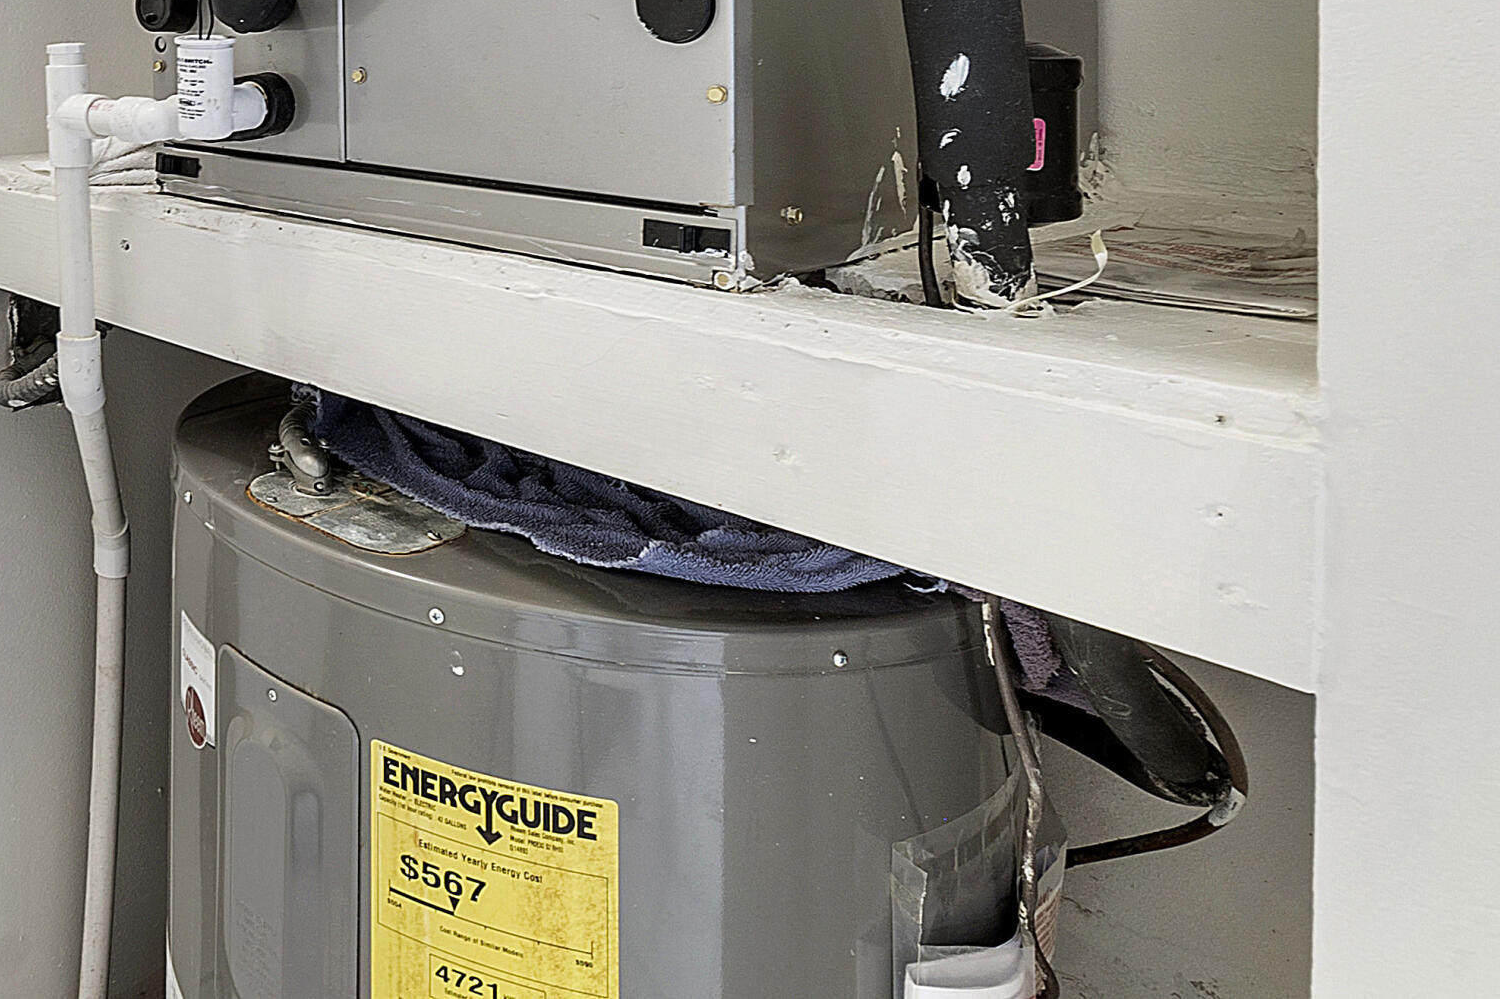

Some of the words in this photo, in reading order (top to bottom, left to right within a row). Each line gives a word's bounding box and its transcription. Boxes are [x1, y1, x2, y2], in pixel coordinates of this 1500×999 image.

[399, 853, 487, 902] $567
[418, 838, 458, 860] Estimated
[461, 853, 488, 871] Yearly
[491, 862, 521, 880] Energy
[523, 870, 543, 884] Cost
[439, 925, 452, 934] Cost
[452, 929, 471, 943] Range
[472, 936, 479, 944] of
[480, 939, 501, 951] Similar
[502, 945, 524, 959] Models
[435, 965, 498, 999] 4721
